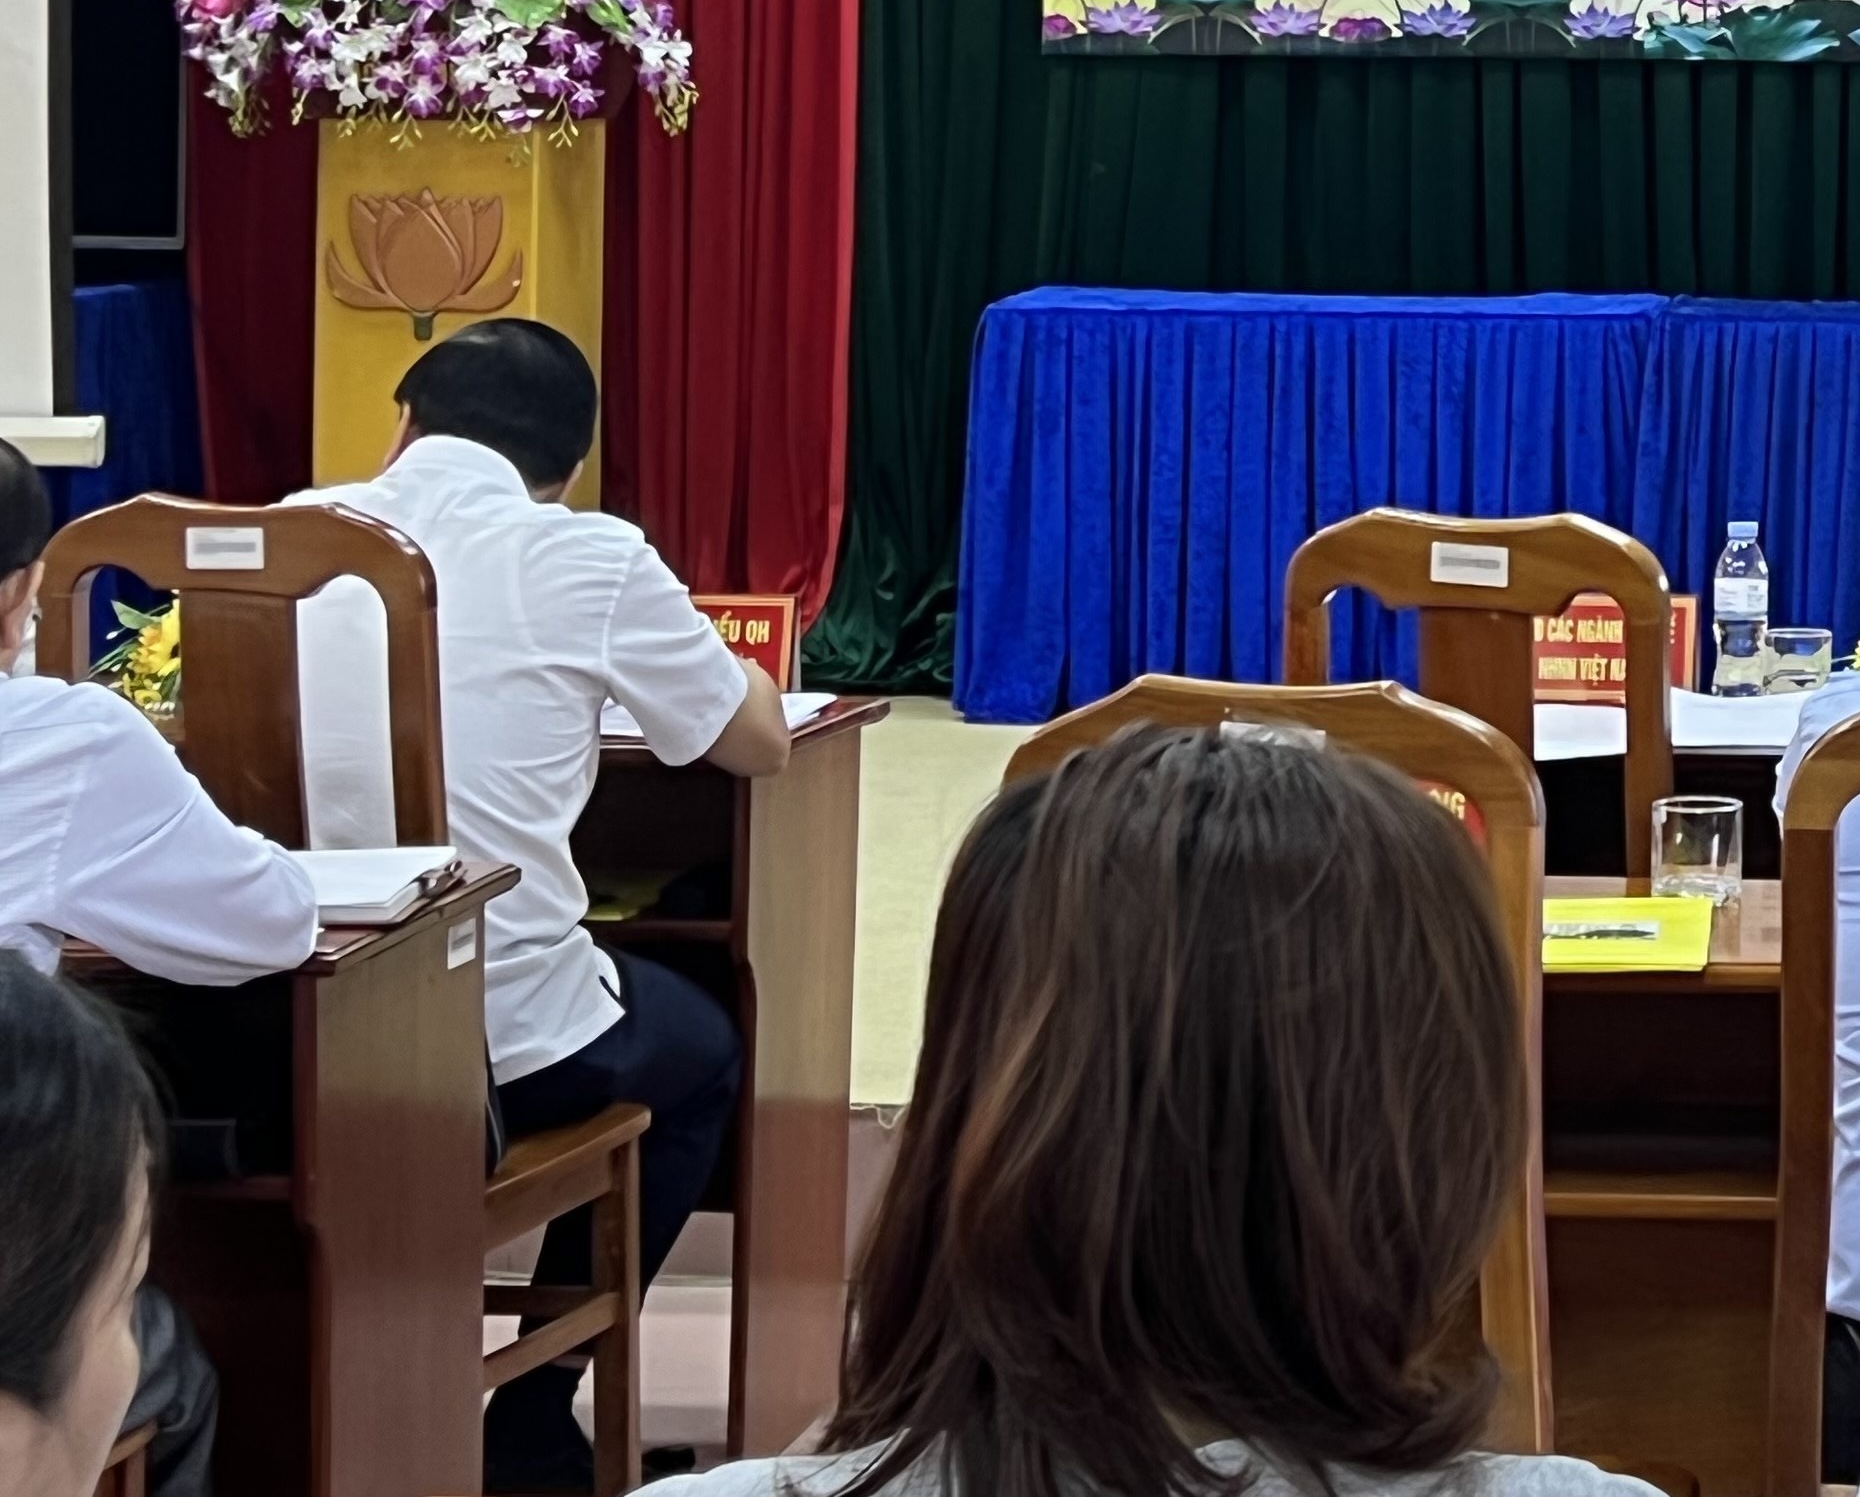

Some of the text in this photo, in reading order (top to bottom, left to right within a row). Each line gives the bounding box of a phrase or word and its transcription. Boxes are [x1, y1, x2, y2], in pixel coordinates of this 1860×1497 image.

[745, 619, 770, 646] QH
[1547, 614, 1574, 643] CÁC
[1580, 653, 1608, 687] VIỆT
